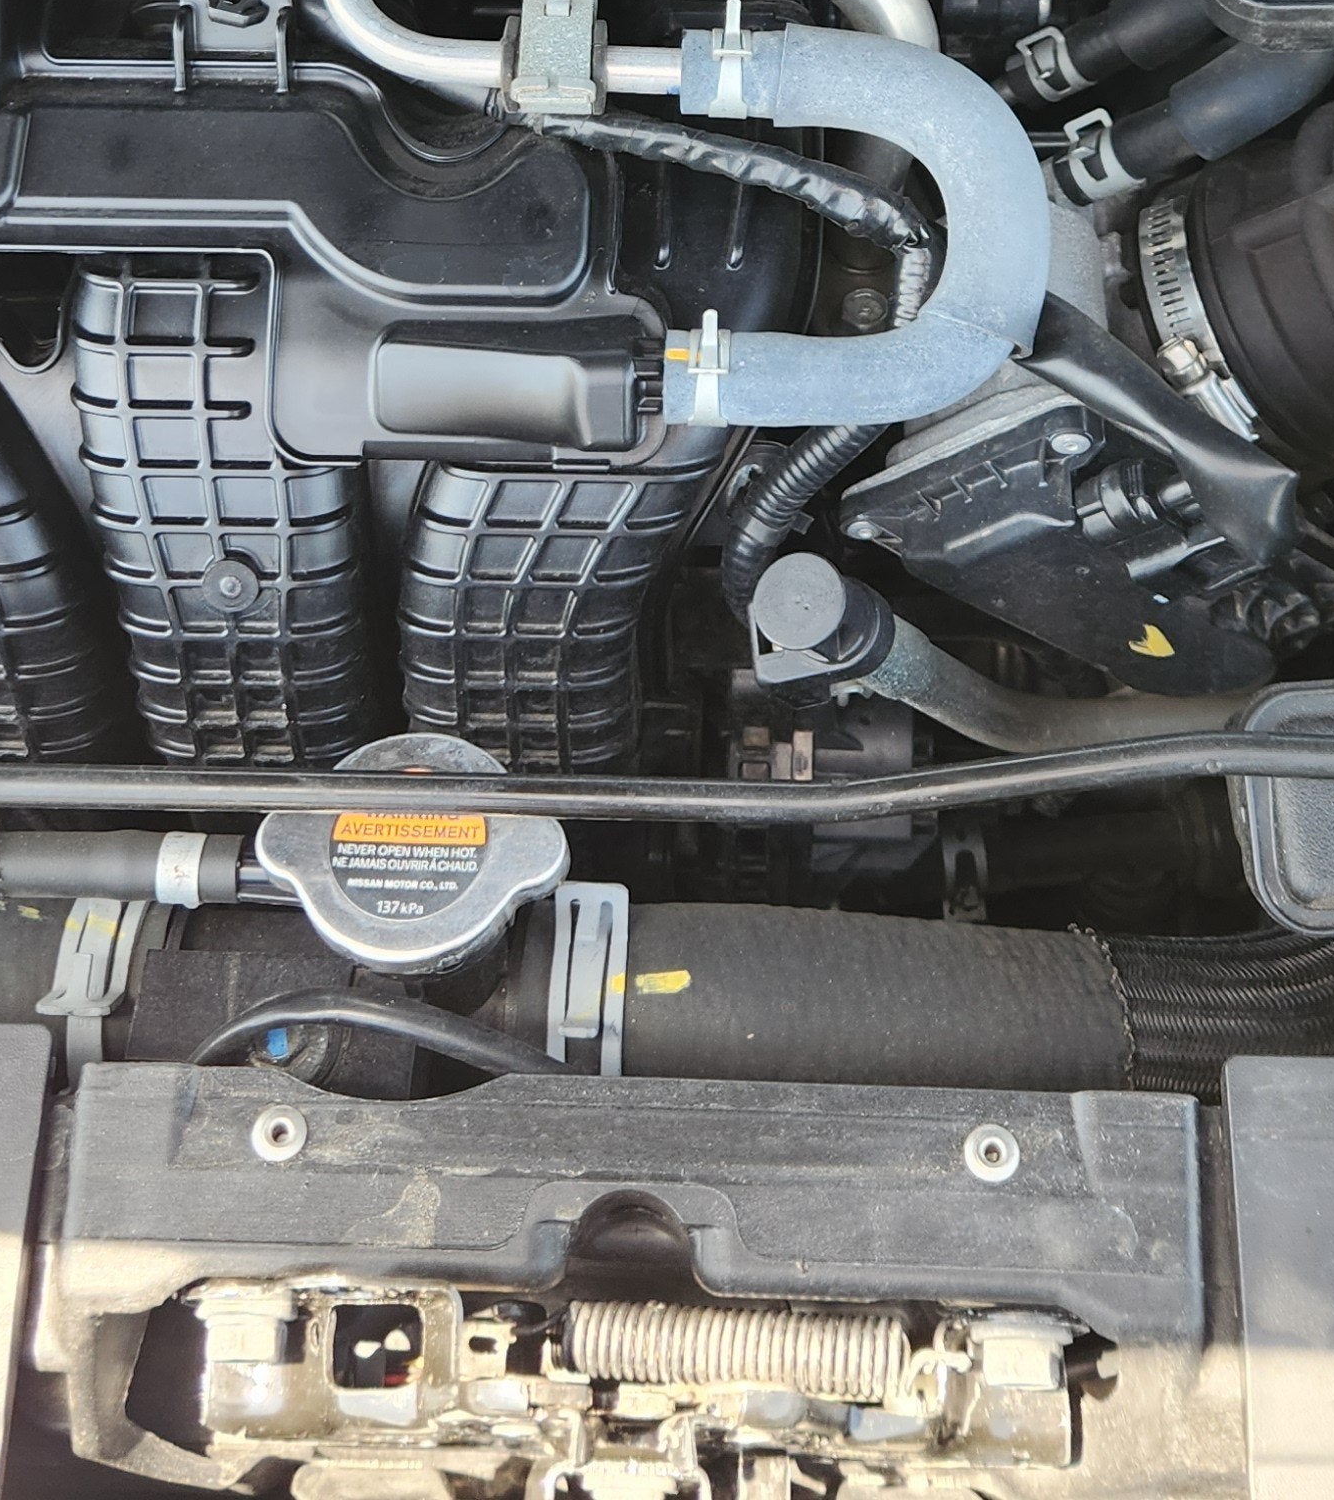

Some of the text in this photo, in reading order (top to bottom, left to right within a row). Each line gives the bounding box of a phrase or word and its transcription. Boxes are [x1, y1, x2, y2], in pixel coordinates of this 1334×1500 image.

[340, 822, 481, 839] AVERTISSEMENT
[337, 842, 477, 859] NEVER OPEN WHEN HOT.
[332, 856, 348, 868] NE
[348, 857, 387, 870] JAMAIS
[388, 858, 429, 871] OUVRIR
[437, 859, 479, 872] CHAUD.
[346, 877, 383, 888] NISSAN
[384, 878, 418, 890] MOTOR
[439, 881, 459, 891] LTD.
